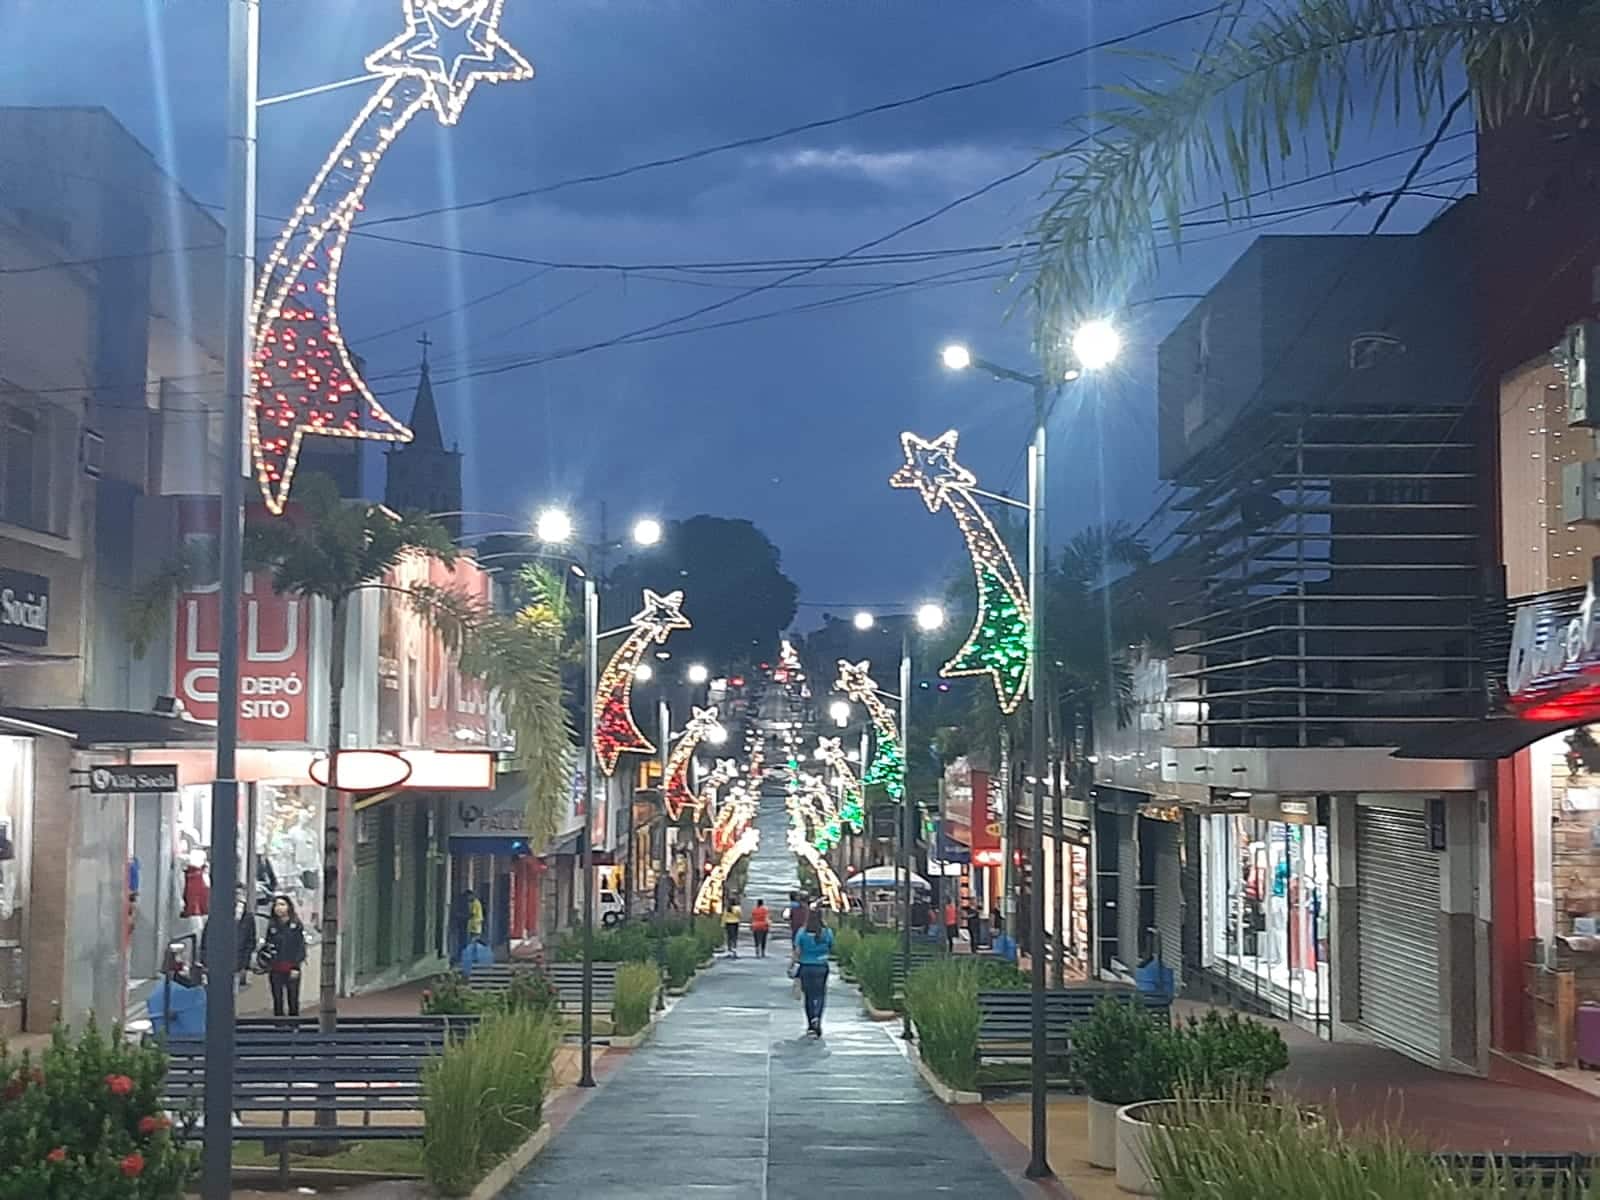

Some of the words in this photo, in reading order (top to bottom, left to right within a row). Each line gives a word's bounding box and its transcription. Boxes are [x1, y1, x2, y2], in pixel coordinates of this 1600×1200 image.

[2, 588, 48, 630] Social
[241, 672, 303, 696] DEPÓ
[241, 700, 291, 718] SITO
